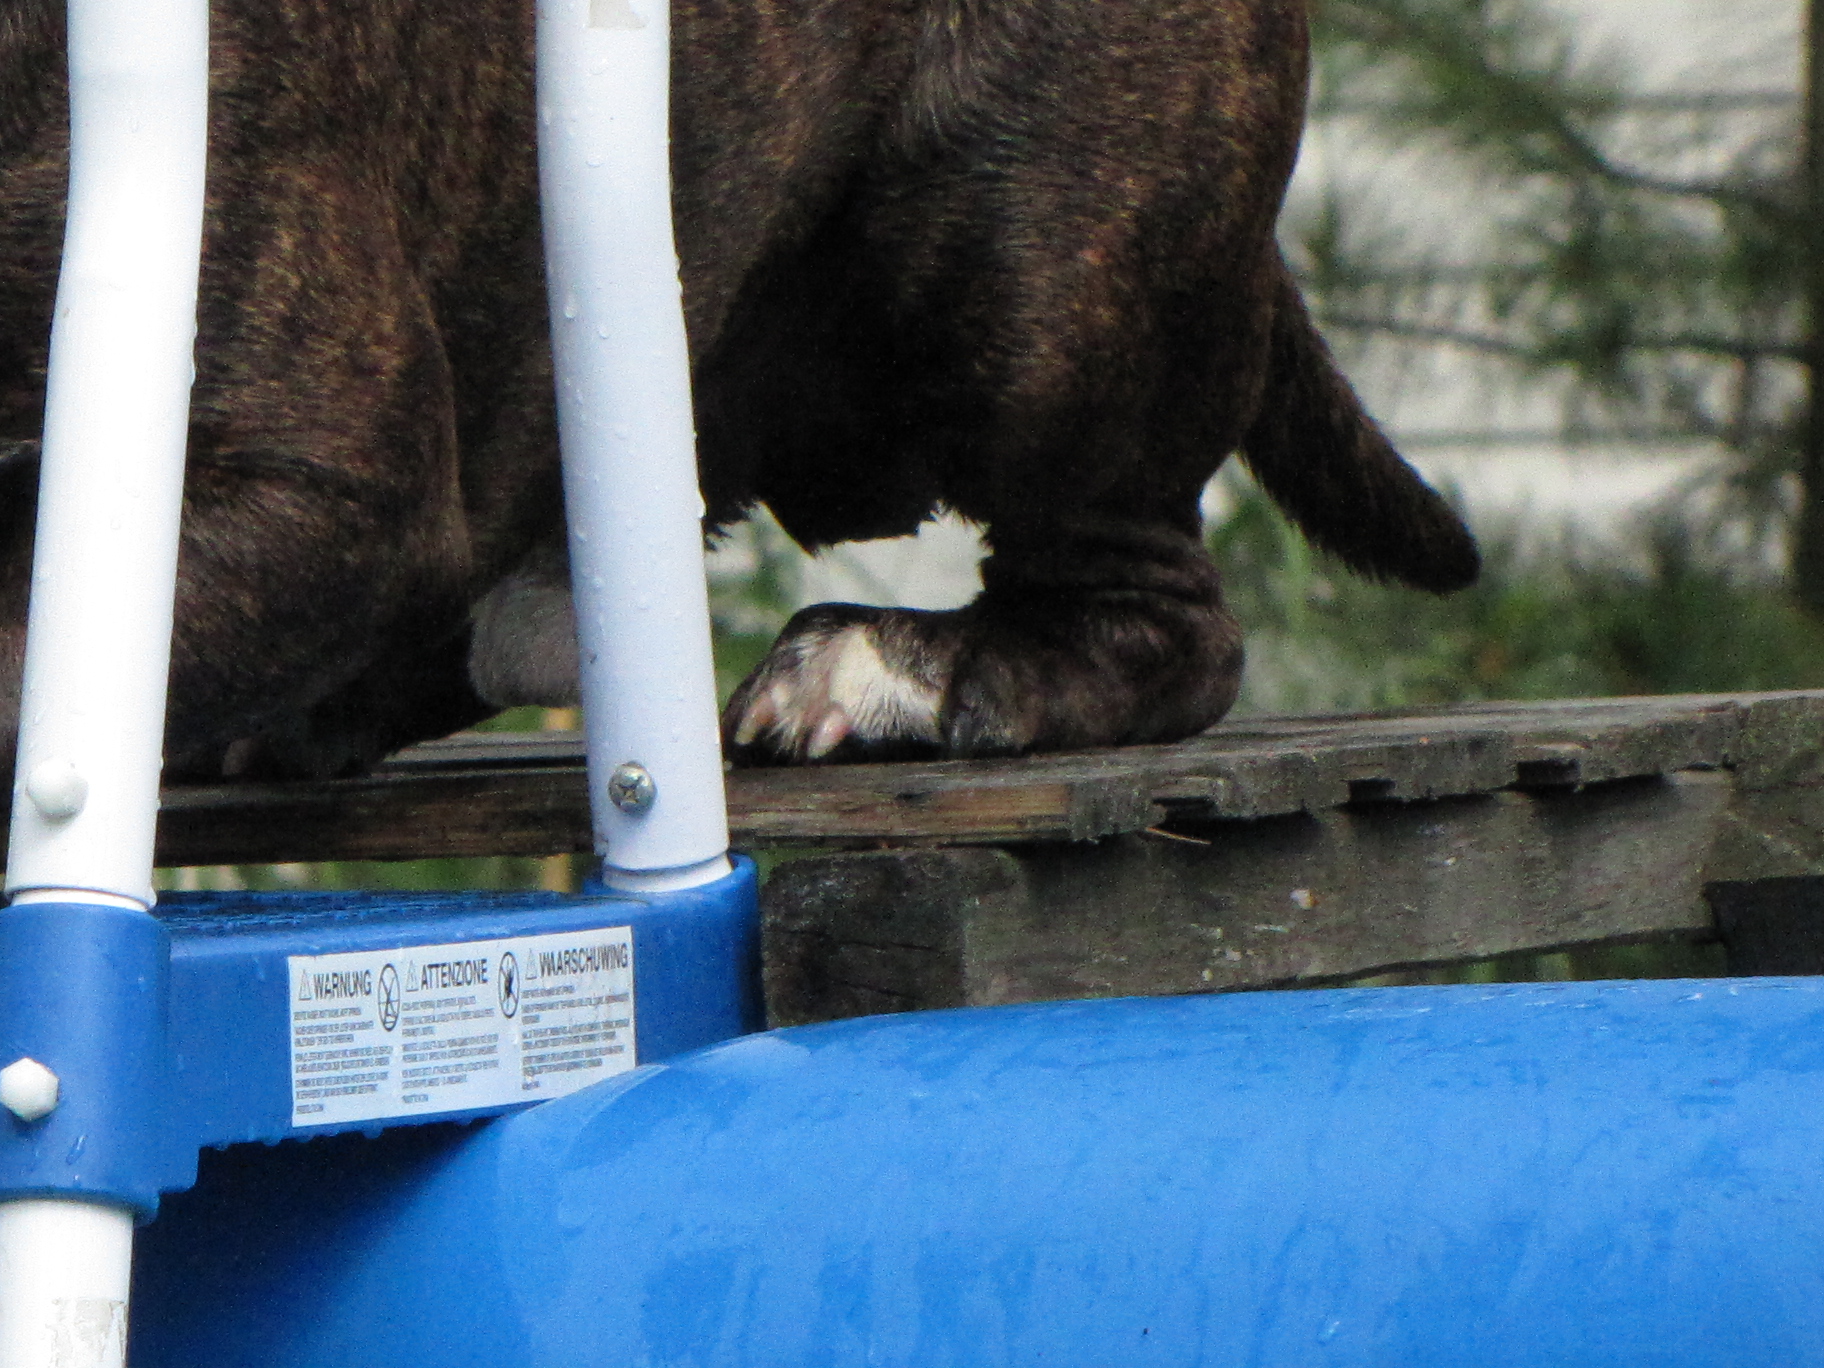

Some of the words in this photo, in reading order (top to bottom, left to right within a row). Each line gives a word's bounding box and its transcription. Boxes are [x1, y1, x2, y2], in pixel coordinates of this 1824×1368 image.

[421, 959, 488, 990] ATTENZIONE
[539, 943, 628, 977] WAARSCHUWING
[313, 969, 372, 1000] WARNUNG
